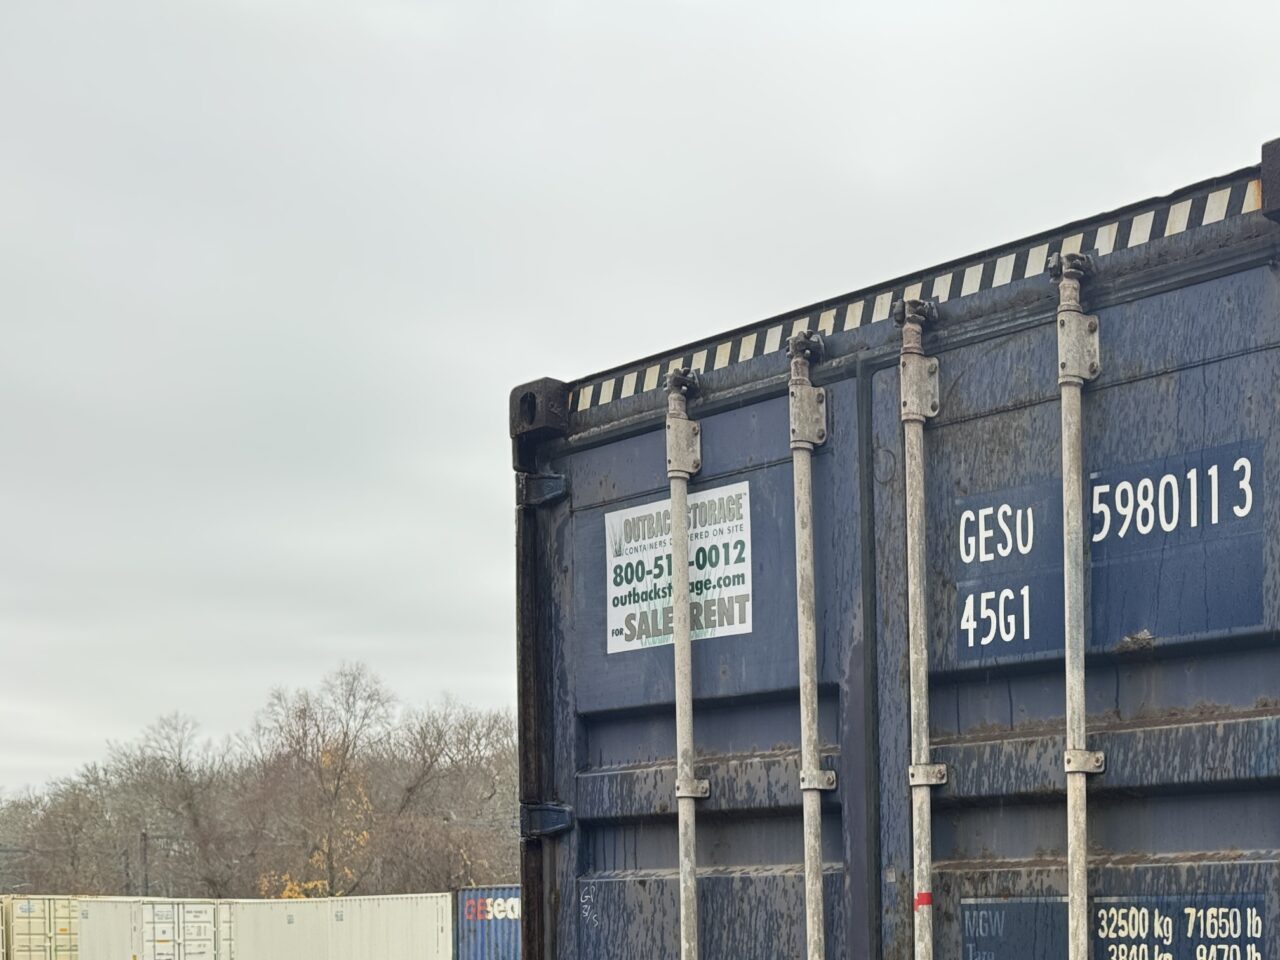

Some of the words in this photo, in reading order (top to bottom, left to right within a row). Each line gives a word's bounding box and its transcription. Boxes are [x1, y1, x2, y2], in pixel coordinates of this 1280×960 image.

[623, 509, 672, 544] OUTBAC
[959, 503, 1034, 564] GESU
[612, 539, 746, 587] 800-51-0012
[612, 573, 746, 608] outbackstage.com
[611, 627, 624, 638] FOR
[624, 606, 674, 643] SALE
[688, 594, 750, 632] RENT
[960, 584, 1031, 648] 45G1
[964, 909, 1006, 938] MGW
[1098, 906, 1149, 939] 32500
[1154, 907, 1173, 945] kg
[1184, 907, 1242, 939] 71650
[1246, 907, 1262, 939] lb
